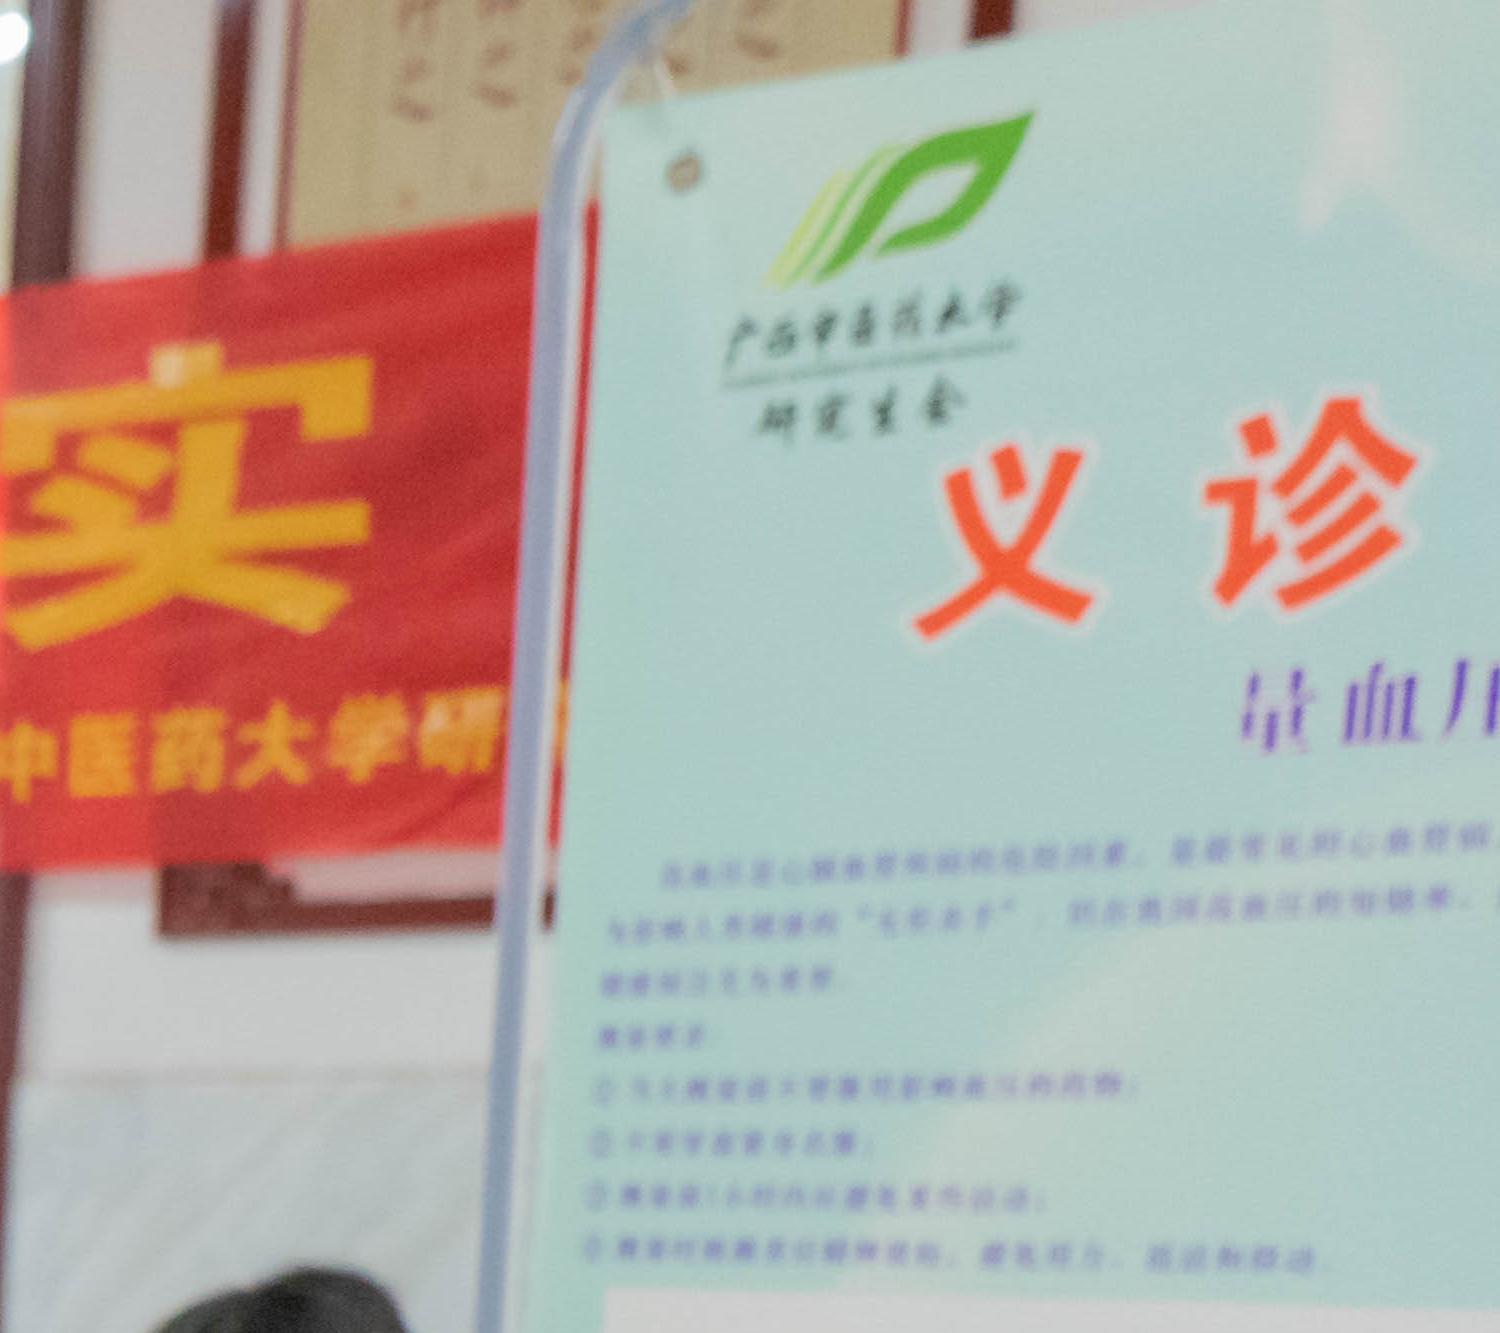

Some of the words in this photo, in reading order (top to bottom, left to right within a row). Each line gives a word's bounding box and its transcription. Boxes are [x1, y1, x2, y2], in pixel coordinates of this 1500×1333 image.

[723, 279, 1024, 368] 广西中医药大学
[754, 372, 968, 441] 研究生会
[911, 394, 1421, 643] 义诊
